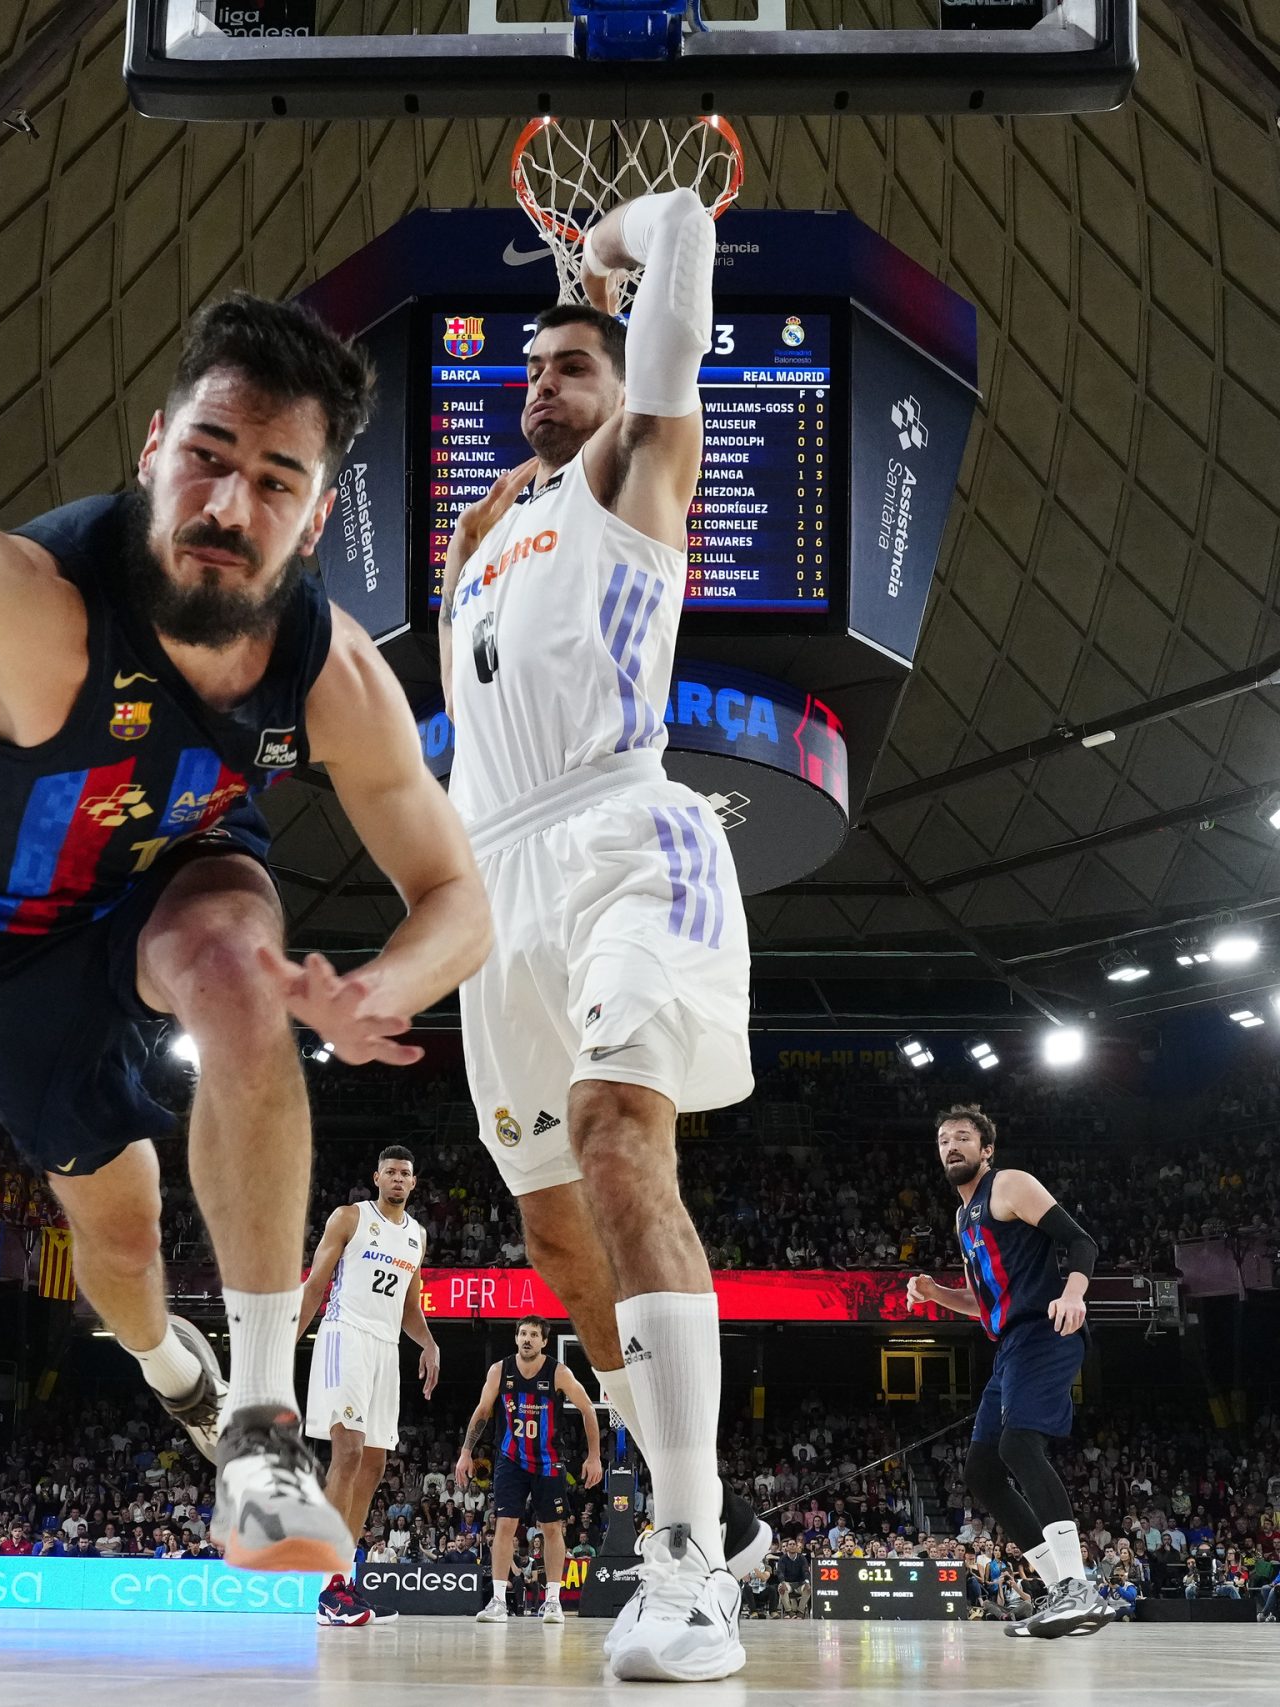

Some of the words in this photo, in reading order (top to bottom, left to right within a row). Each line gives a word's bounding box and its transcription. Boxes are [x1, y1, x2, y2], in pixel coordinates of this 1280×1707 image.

[219, 7, 260, 26] liga
[441, 370, 481, 382] BARÇA
[743, 371, 773, 382] REAL
[776, 371, 825, 382] MADRID
[799, 390, 806, 398] F
[442, 402, 449, 411] 3
[451, 400, 484, 412] PAULÍ
[705, 403, 794, 413] WILLIAMS-GOSS
[798, 403, 805, 413] 0
[816, 403, 823, 413] 0
[442, 419, 449, 428] 5
[705, 419, 756, 429] CAUSEUR
[798, 420, 805, 430] 2
[816, 420, 823, 430] 0
[442, 435, 449, 445] 6
[450, 435, 491, 445] VESELY
[705, 436, 764, 446] RANDOLPH
[798, 437, 805, 447] 0
[816, 437, 823, 447] 0
[436, 452, 448, 461] 10
[450, 452, 495, 461] KALINIC
[704, 453, 750, 463] ABAKDE
[797, 454, 805, 463] 0
[816, 454, 823, 463] 0
[437, 469, 449, 478] 13
[704, 470, 744, 479] HANGA
[798, 471, 804, 480] 1
[816, 471, 823, 480] 3
[434, 486, 448, 495] 20
[704, 487, 755, 497] HEZONJA
[797, 488, 805, 497] 0
[816, 488, 823, 497] 7
[436, 503, 448, 512] 21
[691, 504, 702, 513] 13
[704, 501, 768, 514] RODRÍGUEZ
[798, 505, 804, 514] 1
[815, 505, 823, 514] 0
[878, 458, 903, 550] Sanitària
[338, 468, 359, 562] Sanitària
[353, 462, 380, 592] Assistència
[435, 519, 448, 528] 22
[691, 520, 702, 530] 21
[704, 520, 758, 530] CORNELIE
[797, 521, 805, 530] 2
[815, 521, 823, 531] 0
[887, 465, 918, 598] Assistència
[435, 536, 448, 545] 23
[689, 537, 702, 546] 22
[704, 537, 753, 547] TAVARES
[797, 538, 804, 547] 0
[815, 538, 823, 547] 6
[689, 553, 702, 563] 23
[704, 553, 736, 563] LLULL
[797, 554, 804, 564] 0
[815, 554, 823, 564] 0
[688, 570, 702, 579] 28
[704, 570, 759, 580] YABUSELE
[797, 571, 804, 580] 0
[815, 571, 822, 580] 3
[690, 587, 702, 596] 31
[703, 587, 737, 596] MUSA
[797, 588, 803, 597] 1
[812, 588, 824, 597] 14
[533, 1118, 561, 1136] adidas
[362, 1250, 416, 1274] AUTOHERO
[372, 1269, 399, 1297] 22
[450, 1278, 496, 1309] PER
[508, 1279, 535, 1309] LA
[513, 1418, 538, 1439] 20
[362, 1567, 478, 1592] endesa
[820, 1568, 839, 1581] 28
[858, 1568, 893, 1581] 6:11
[909, 1571, 918, 1581] 2
[938, 1570, 958, 1581] 33
[110, 1564, 306, 1608] endesa
[824, 1601, 831, 1612] 1
[946, 1602, 954, 1612] 3
